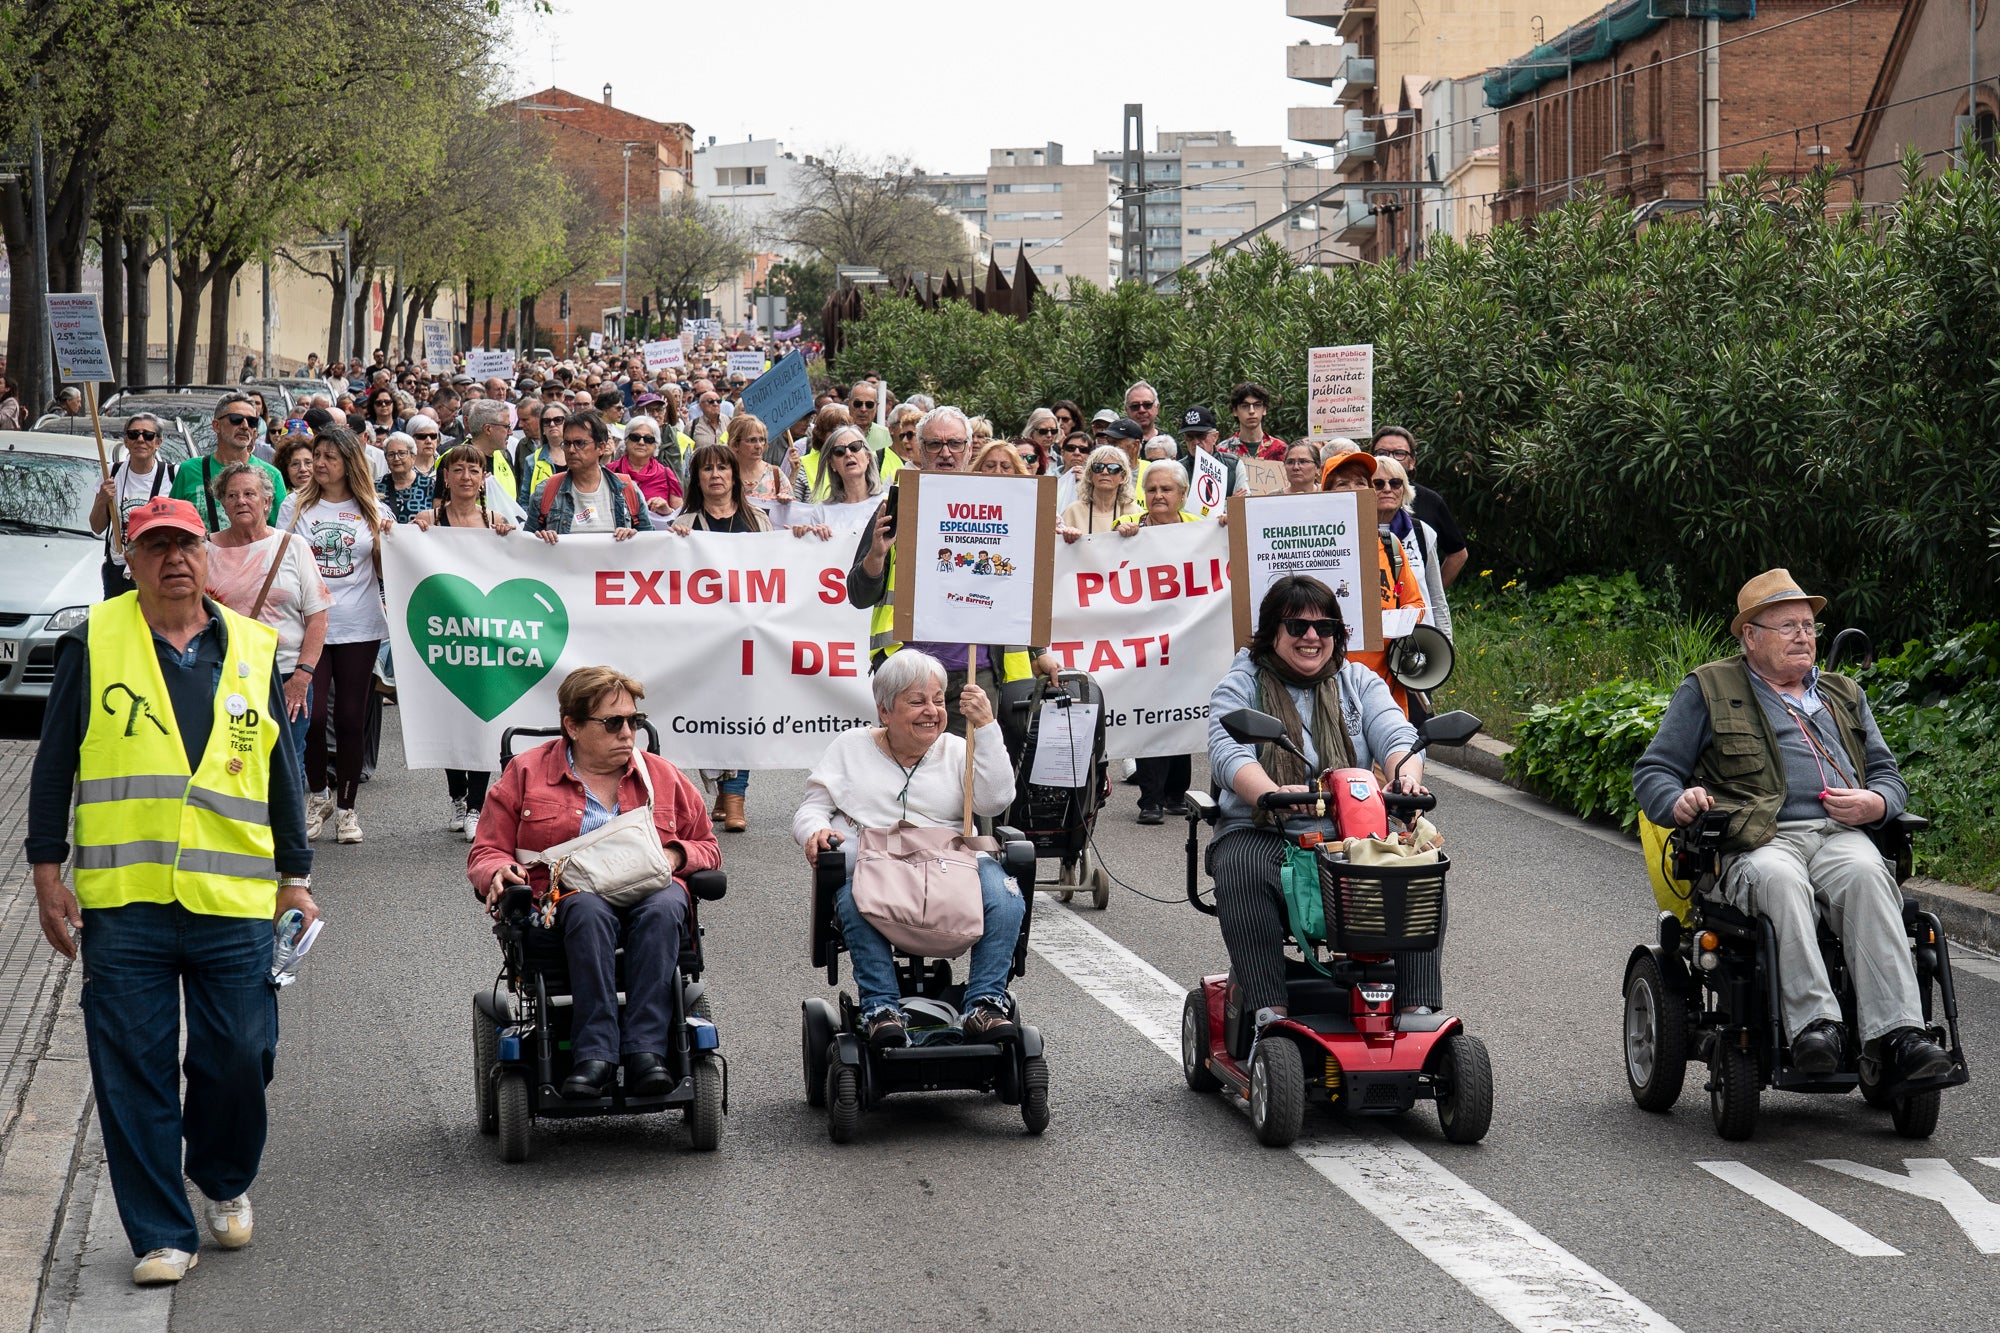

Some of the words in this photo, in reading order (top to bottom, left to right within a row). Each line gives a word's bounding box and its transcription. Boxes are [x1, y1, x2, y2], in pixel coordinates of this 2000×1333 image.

[54, 321, 80, 330] Urgent!
[57, 332, 75, 340] 25%
[649, 355, 679, 365] DIMISSIÓ
[1313, 374, 1320, 382] la
[1325, 371, 1365, 382] sanitat:
[747, 384, 773, 411] SANITAT
[1312, 384, 1352, 400] pública
[771, 384, 807, 424] QUALITAT
[1330, 405, 1365, 414] Qualitat
[1200, 456, 1208, 467] NO
[1214, 465, 1221, 475] LA
[1200, 464, 1222, 483] GUERRA
[947, 503, 1003, 520] VOLEM
[940, 521, 1009, 534] ESPECIALISTES
[1263, 521, 1346, 539] REHABILITACIÓ
[955, 536, 1001, 545] DISCAPACITAT
[1271, 537, 1336, 550] CONTINUADA
[1257, 552, 1270, 561] PER
[1271, 552, 1276, 560] A
[1273, 560, 1304, 570] PERSONES
[1306, 557, 1340, 568] CRÒNIQUES
[595, 568, 786, 605] EXIGIM
[1076, 559, 1231, 607] PÚBLI
[428, 616, 543, 640] SANITAT
[428, 640, 544, 668] PÚBLICA
[742, 640, 754, 676] I
[791, 641, 857, 677] DE
[671, 716, 766, 735] Comissió
[772, 714, 872, 734] d'entitats
[1133, 704, 1210, 725] Terrassa
